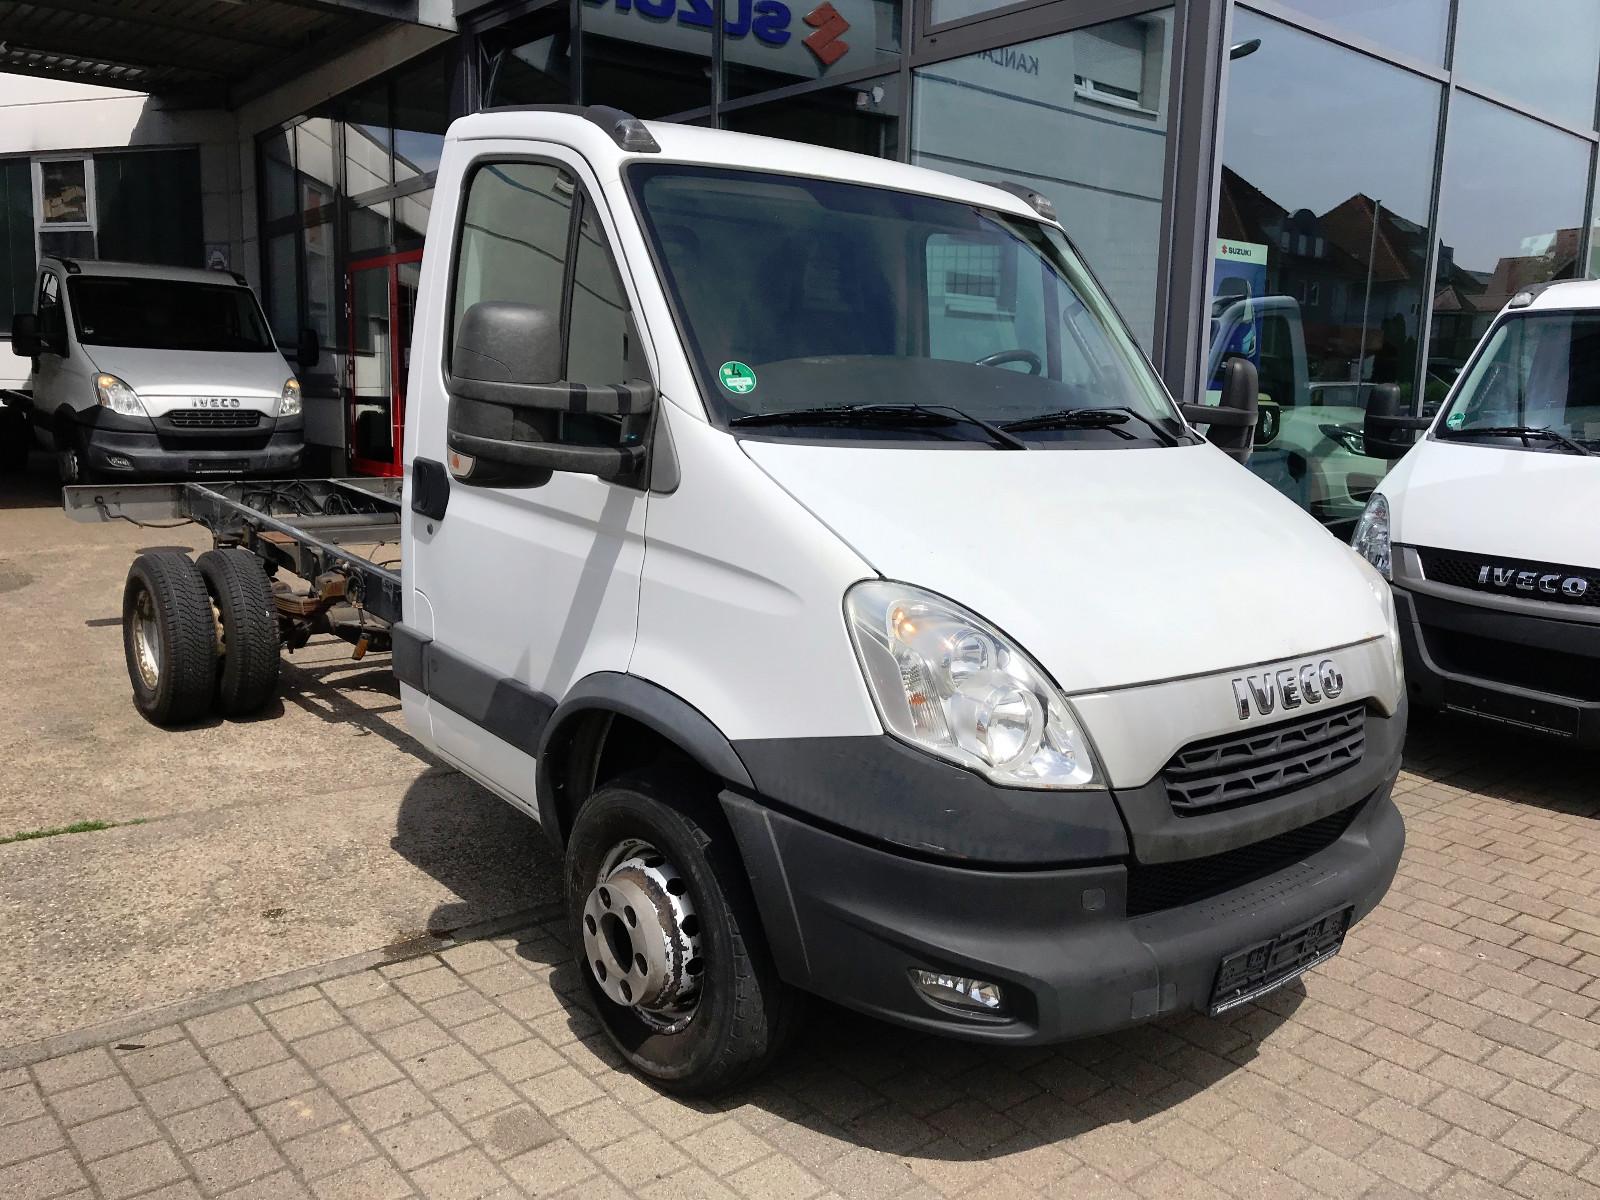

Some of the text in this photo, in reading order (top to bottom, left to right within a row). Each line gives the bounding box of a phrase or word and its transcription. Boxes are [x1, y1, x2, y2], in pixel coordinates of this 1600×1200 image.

[1228, 246, 1252, 257] SUZUKI
[191, 397, 240, 408] IVECO
[1477, 565, 1588, 597] IVECO
[1231, 659, 1344, 720] IVECO
